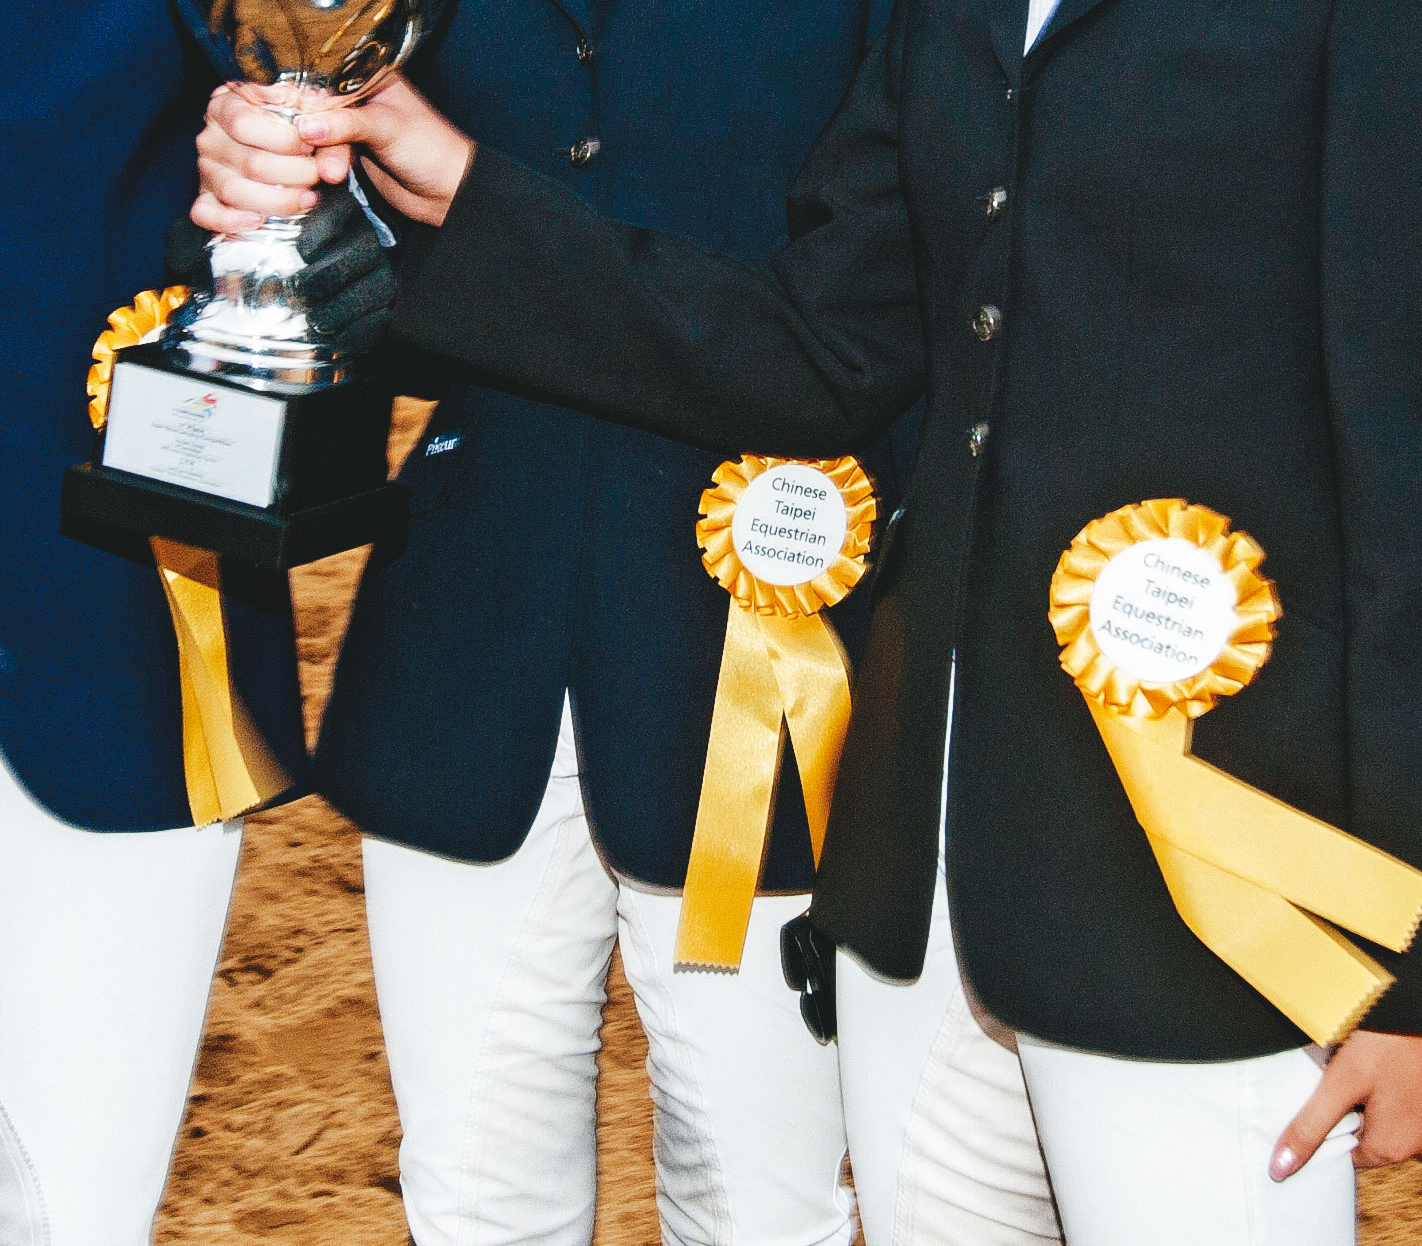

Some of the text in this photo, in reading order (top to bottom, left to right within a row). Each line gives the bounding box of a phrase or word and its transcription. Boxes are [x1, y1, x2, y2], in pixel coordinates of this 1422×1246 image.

[771, 477, 827, 501] Chinese
[775, 499, 817, 522] Taipei
[750, 518, 827, 547] Equestrian
[741, 540, 825, 569] Association
[1143, 552, 1212, 590] Chinese
[1144, 578, 1196, 611] Taipei
[1111, 594, 1205, 642] Equestrian
[1098, 619, 1199, 667] Association
